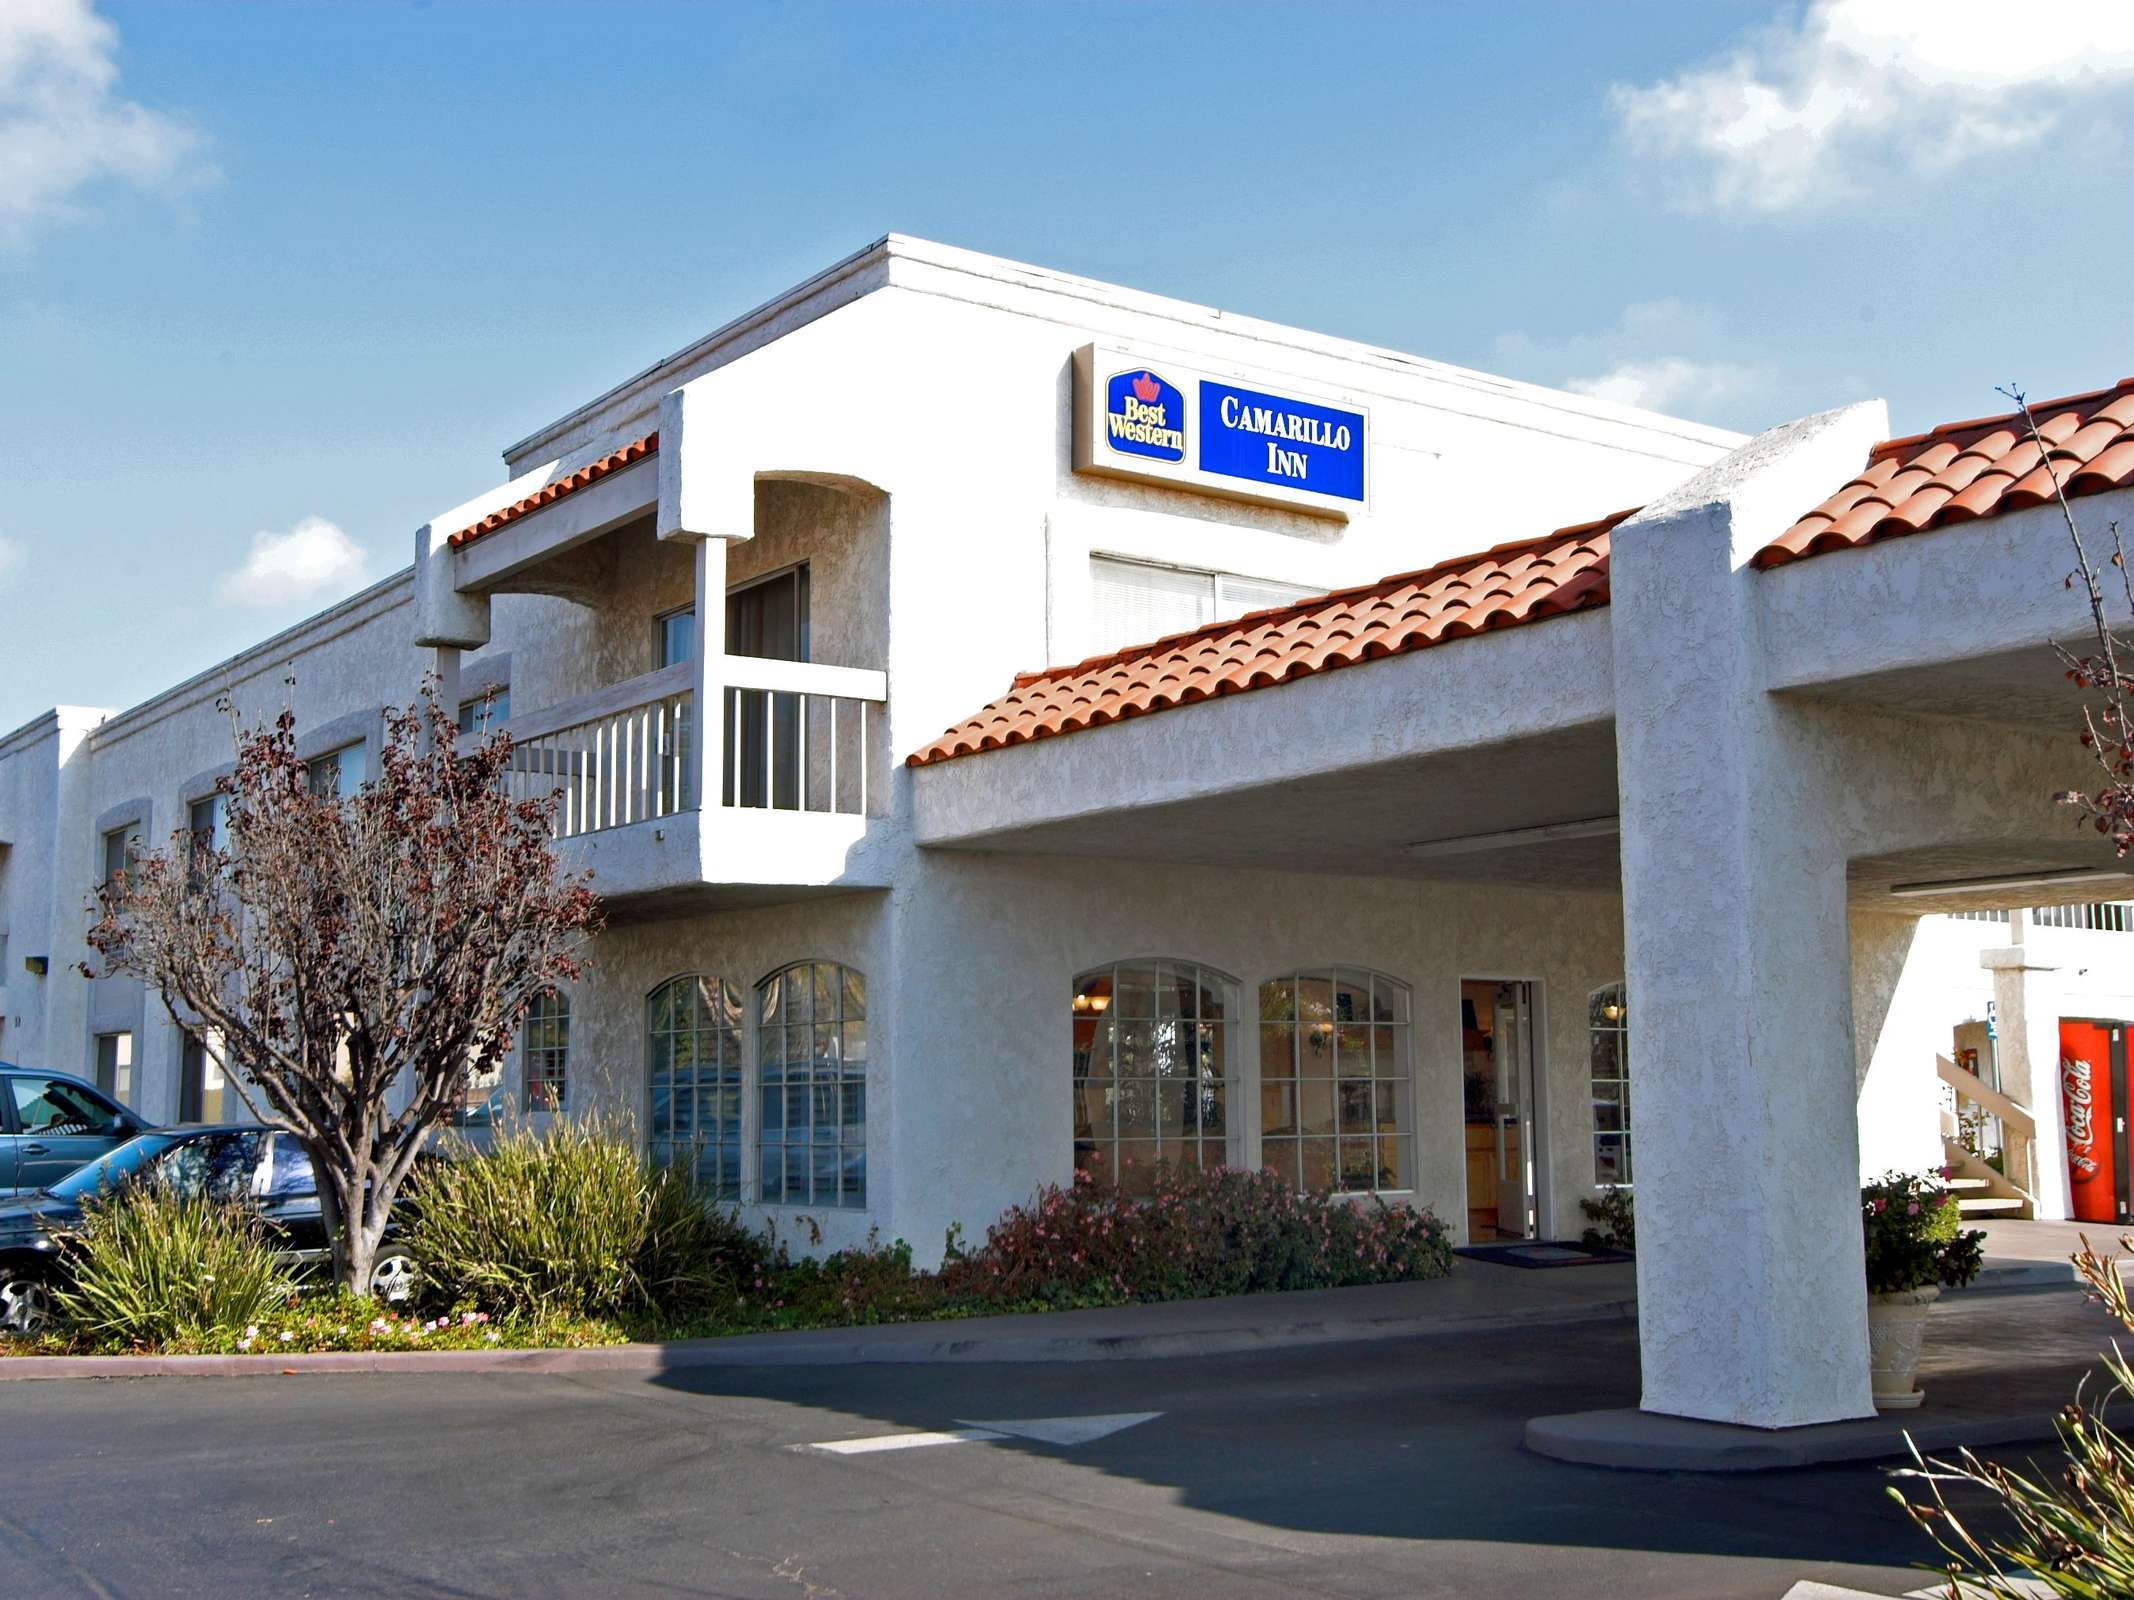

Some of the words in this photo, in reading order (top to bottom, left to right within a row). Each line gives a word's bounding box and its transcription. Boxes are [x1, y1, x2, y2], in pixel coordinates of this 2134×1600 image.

[1124, 396, 1166, 427] Best
[1220, 396, 1350, 451] CAMARILLO
[1108, 411, 1184, 451] Western
[1267, 443, 1308, 479] INN
